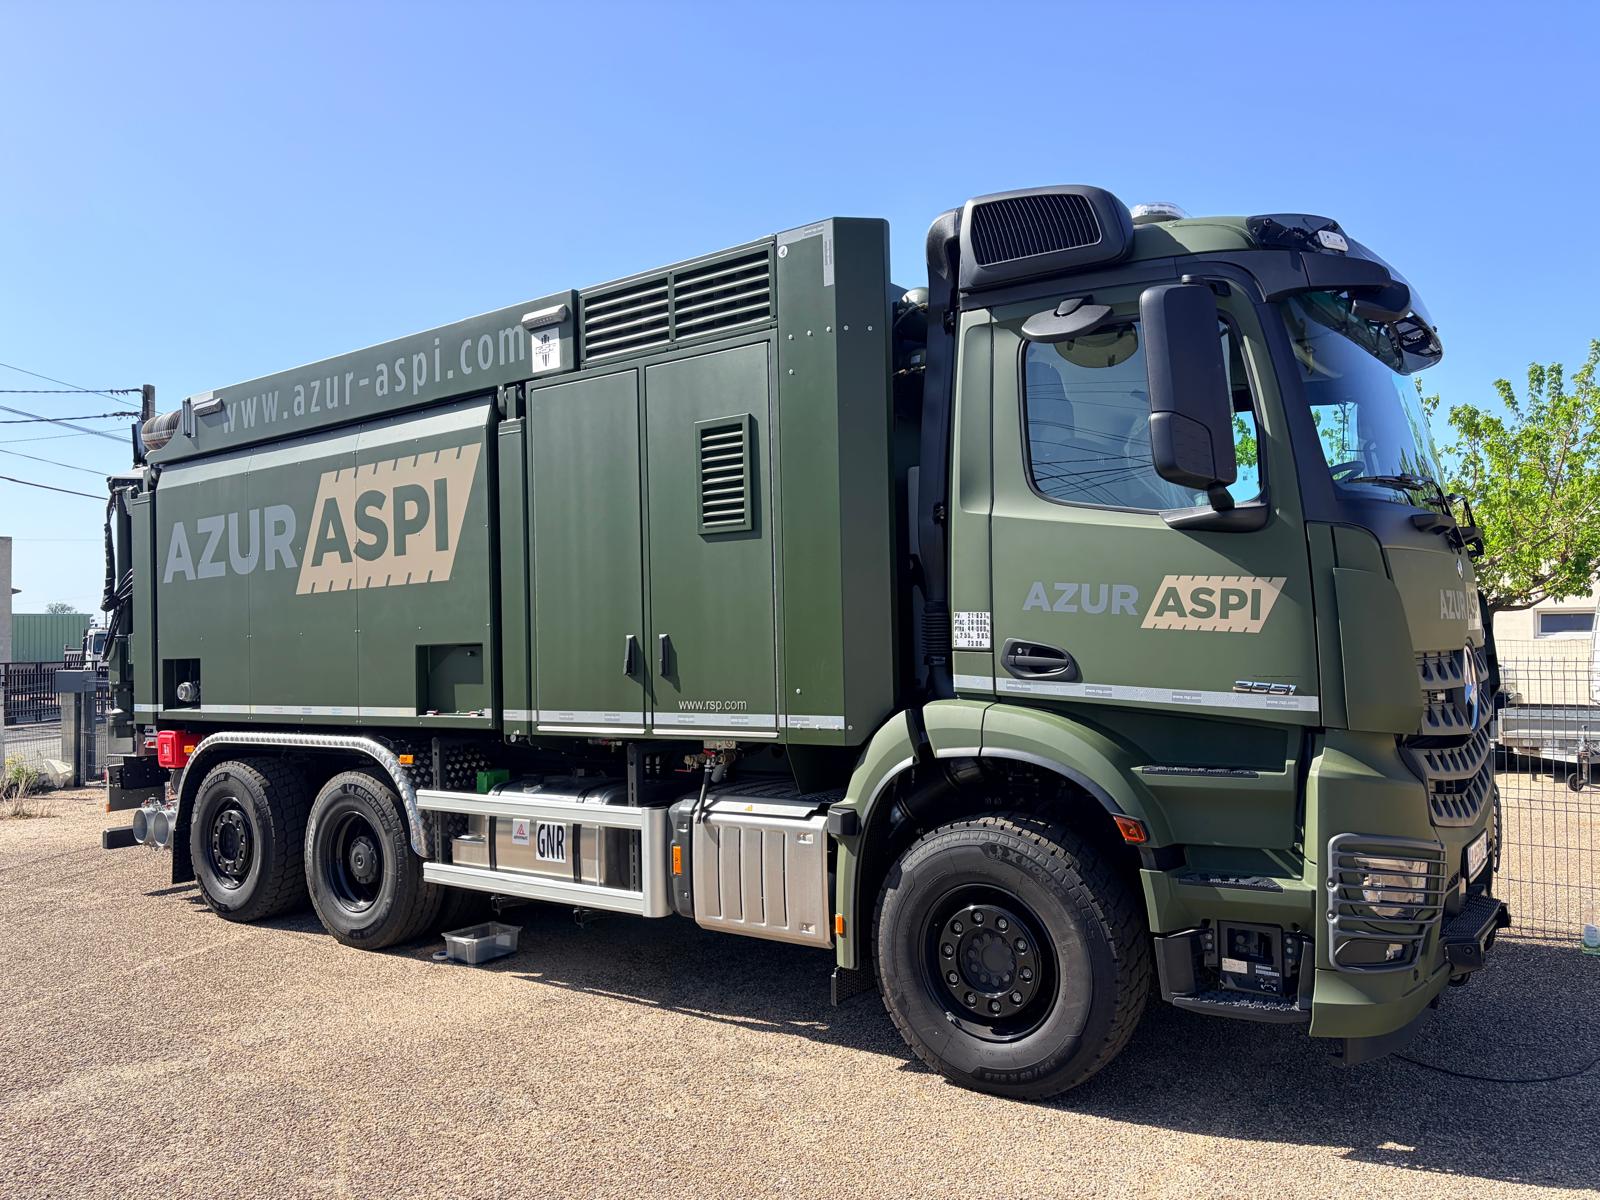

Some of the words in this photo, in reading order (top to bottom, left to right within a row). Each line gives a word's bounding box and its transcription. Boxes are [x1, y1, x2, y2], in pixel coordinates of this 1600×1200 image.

[222, 323, 525, 434] www.azur-aspi.com
[163, 503, 298, 584] AZUR
[310, 477, 449, 568] ASPI
[1022, 581, 1139, 616] AZUR
[1153, 586, 1262, 621] ASPI
[1440, 589, 1467, 620] AZUR
[678, 700, 747, 713] www.rsp.com
[537, 823, 565, 860] GNR
